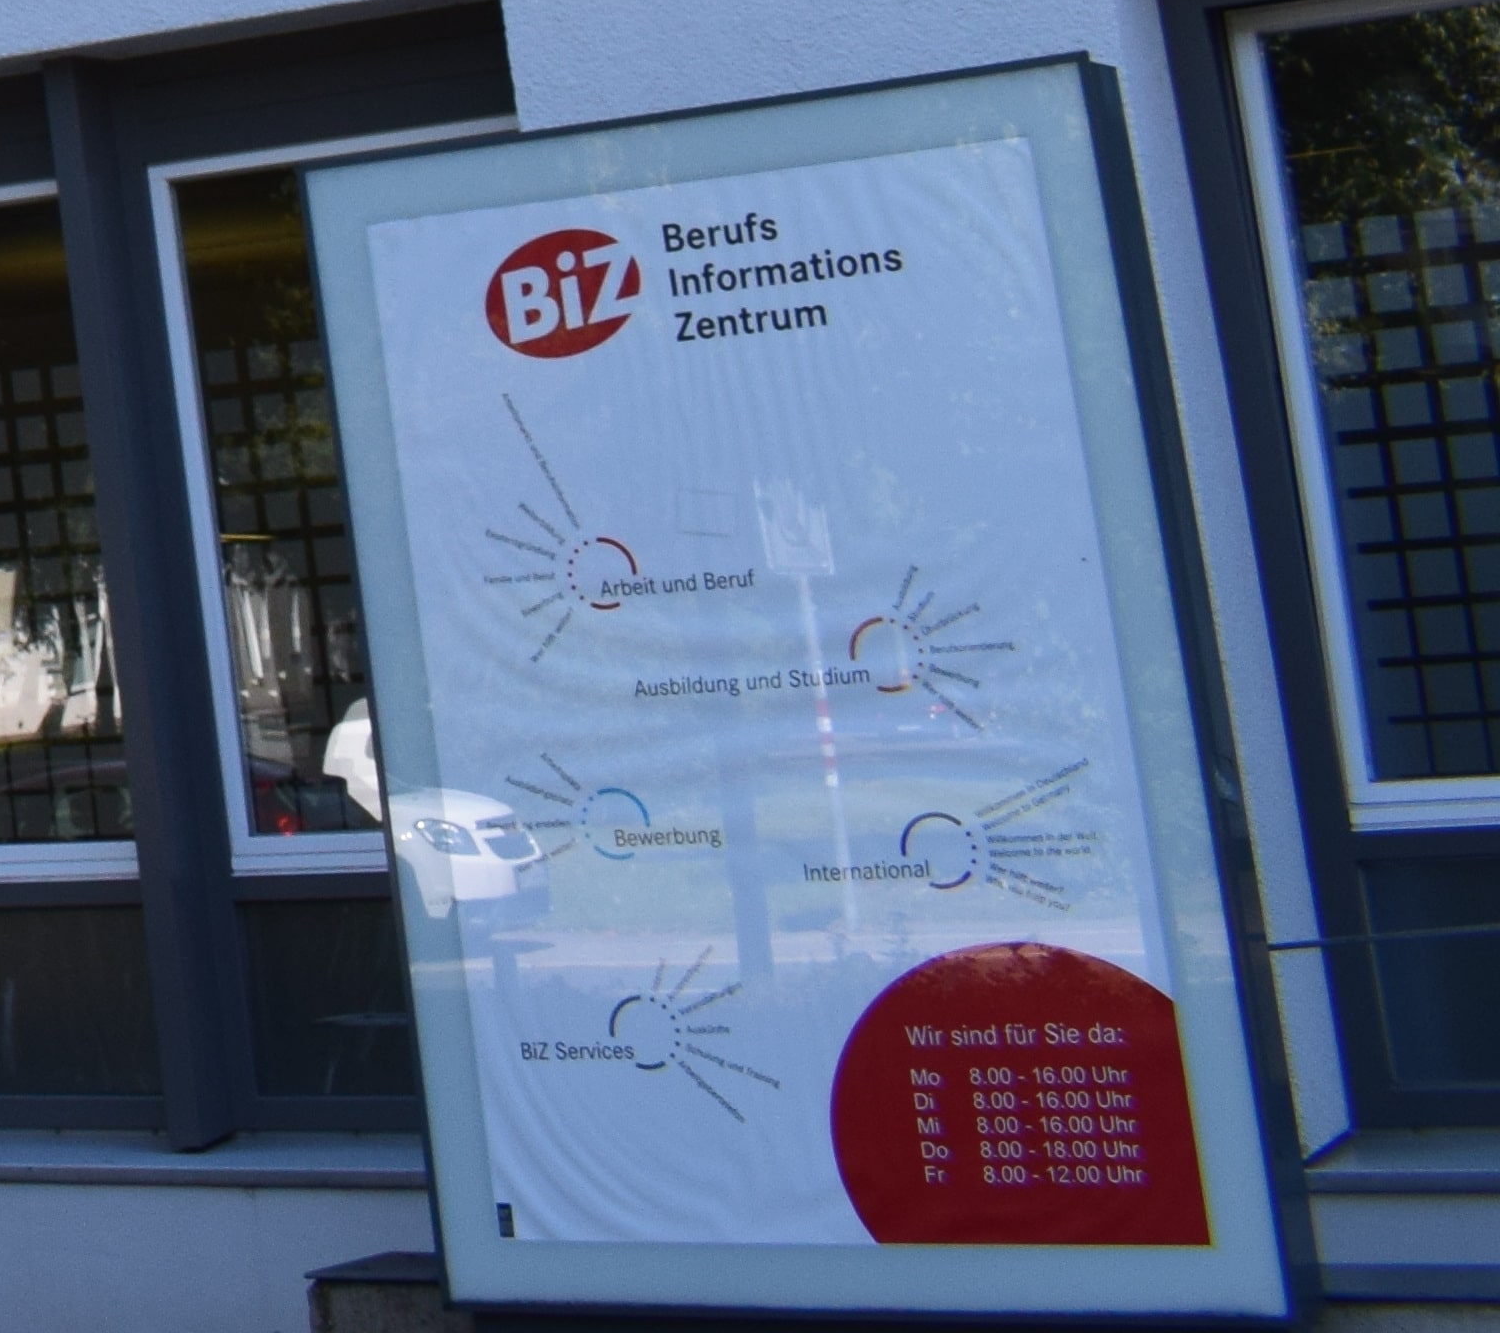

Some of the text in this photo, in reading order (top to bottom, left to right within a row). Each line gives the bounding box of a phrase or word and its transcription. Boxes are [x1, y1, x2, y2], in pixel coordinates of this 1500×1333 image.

[662, 212, 779, 254] Berufs
[668, 248, 903, 297] Informations
[501, 240, 640, 345] BiZ
[674, 303, 828, 342] Zentrum
[601, 568, 756, 598] Arbeit und Beruf
[634, 666, 871, 697] Ausbildung und Studium
[614, 827, 722, 849] Bewerbung
[803, 859, 931, 883] International
[905, 1021, 1124, 1045] Wir sind für Sie da:
[520, 1040, 635, 1061] BiZ Services
[910, 1068, 940, 1085] Mo
[969, 1067, 1011, 1084] 8.00
[1032, 1066, 1085, 1084] 16.00
[1092, 1066, 1128, 1084] Uhr
[914, 1092, 934, 1109] Di
[973, 1091, 1015, 1109] 8.00
[1036, 1091, 1089, 1109] 16.00
[1096, 1090, 1132, 1108] Uhr
[917, 1117, 940, 1134] Mi
[976, 1116, 1018, 1134] 8.00
[1039, 1116, 1093, 1133] 16.00
[1099, 1115, 1136, 1133] Uhr
[920, 1142, 949, 1159] Do
[980, 1141, 1022, 1158] 8.00
[1043, 1140, 1097, 1158] 18.00
[1103, 1140, 1139, 1158] Uhr
[924, 1166, 945, 1183] Fr
[983, 1165, 1026, 1183] 8.00
[1046, 1165, 1100, 1183] 12.00
[1107, 1165, 1143, 1183] Uhr
